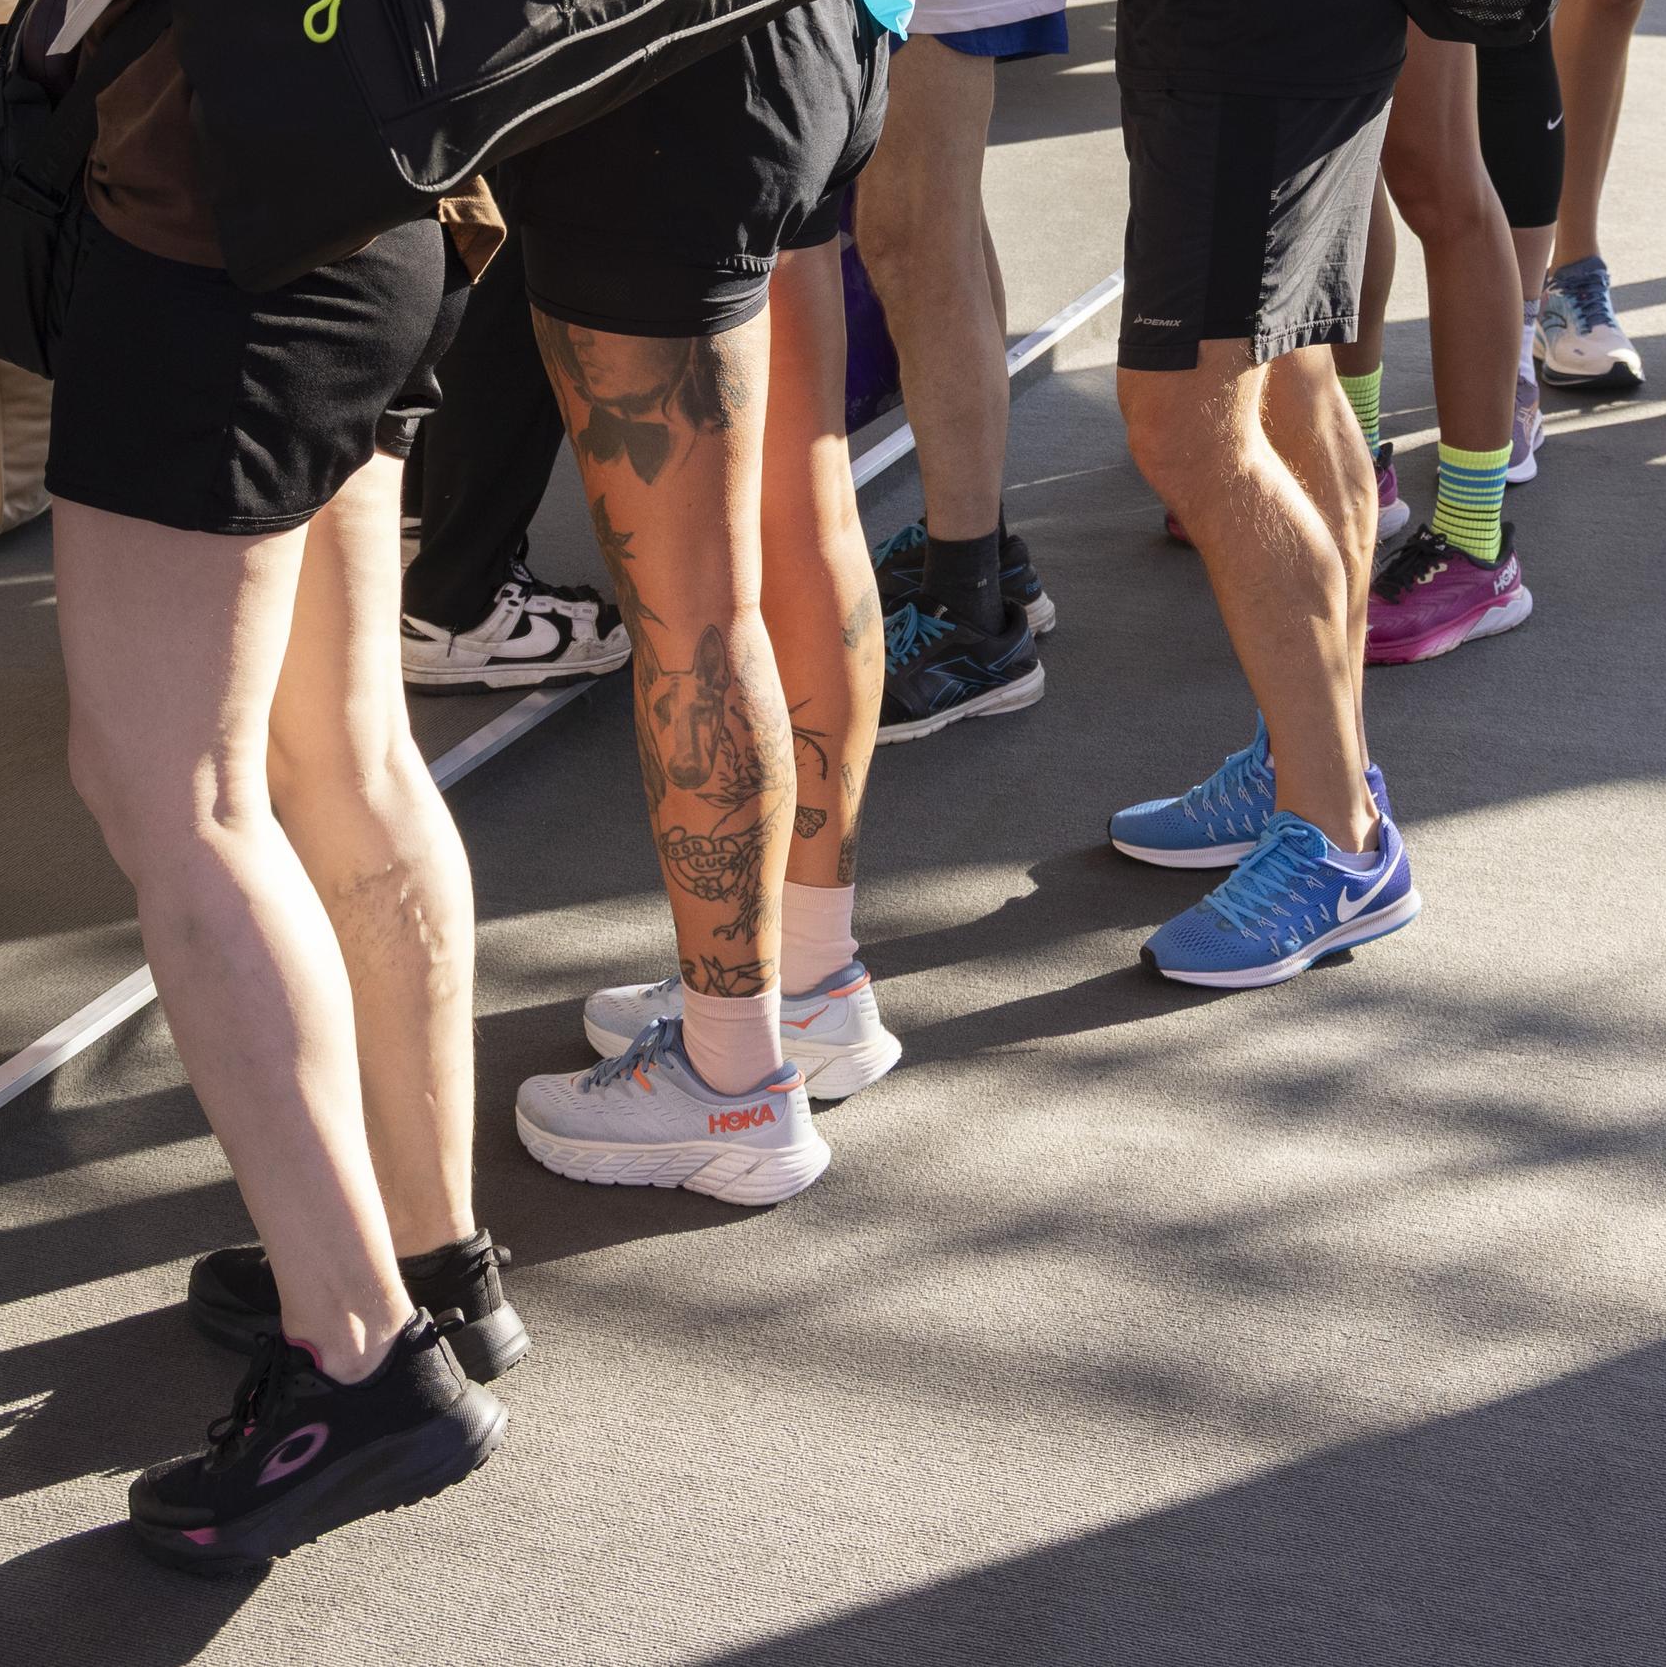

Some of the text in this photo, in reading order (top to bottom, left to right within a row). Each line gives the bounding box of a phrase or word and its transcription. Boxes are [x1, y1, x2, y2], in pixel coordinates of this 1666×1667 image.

[1143, 317, 1182, 328] DEMIX
[1493, 555, 1518, 596] HOKA
[695, 855, 733, 870] LUC
[708, 1103, 777, 1135] HOKA
